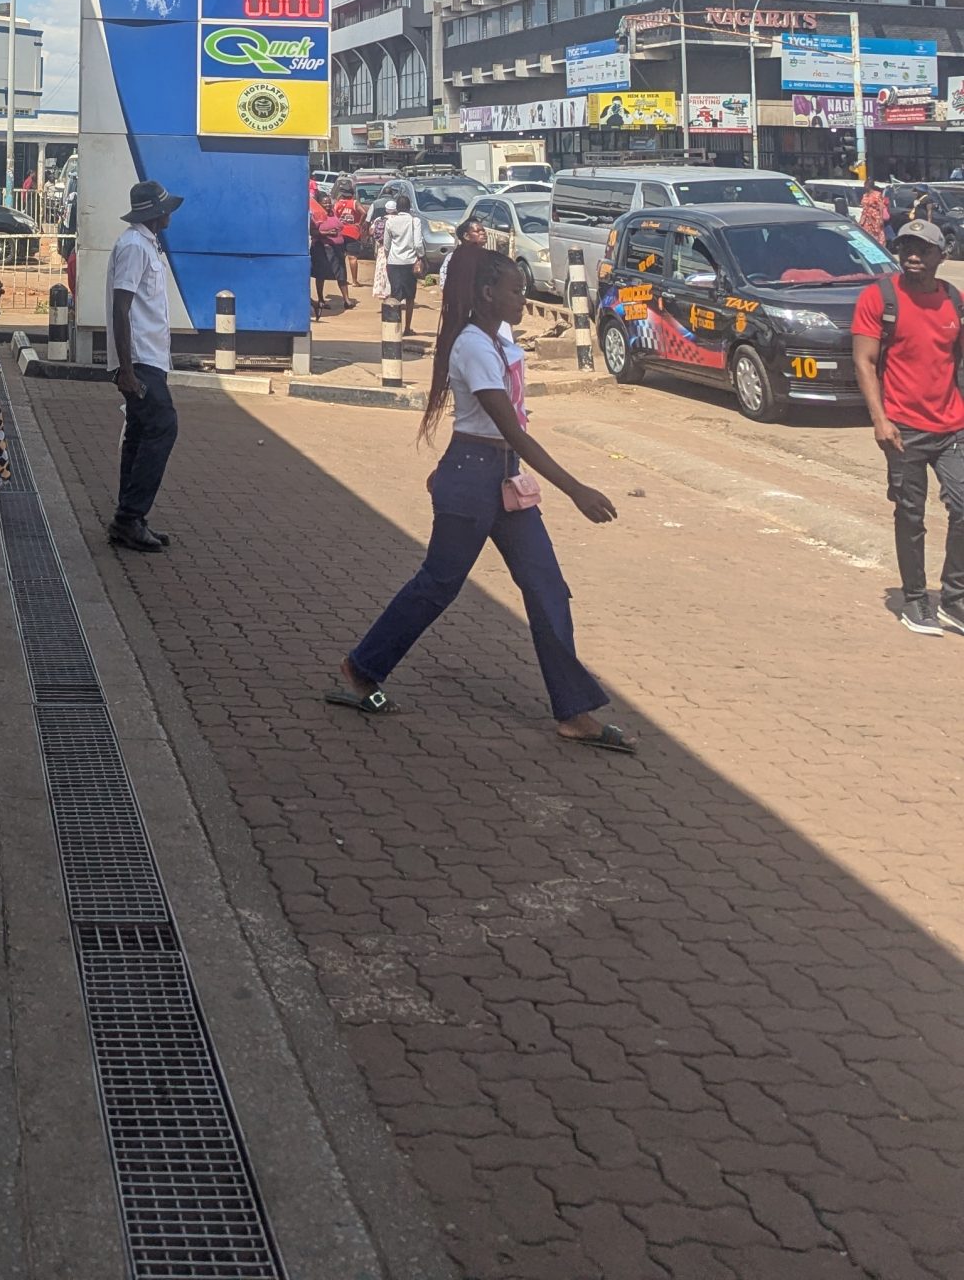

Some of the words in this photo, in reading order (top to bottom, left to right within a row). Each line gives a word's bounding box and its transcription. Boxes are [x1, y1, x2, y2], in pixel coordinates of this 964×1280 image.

[289, 58, 325, 70] SHOP
[244, 84, 285, 101] HOTPLATE
[827, 99, 874, 113] NAGAJI
[240, 112, 287, 131] GRILLHOUSE
[725, 296, 761, 313] TAXI
[791, 356, 818, 379] 10
